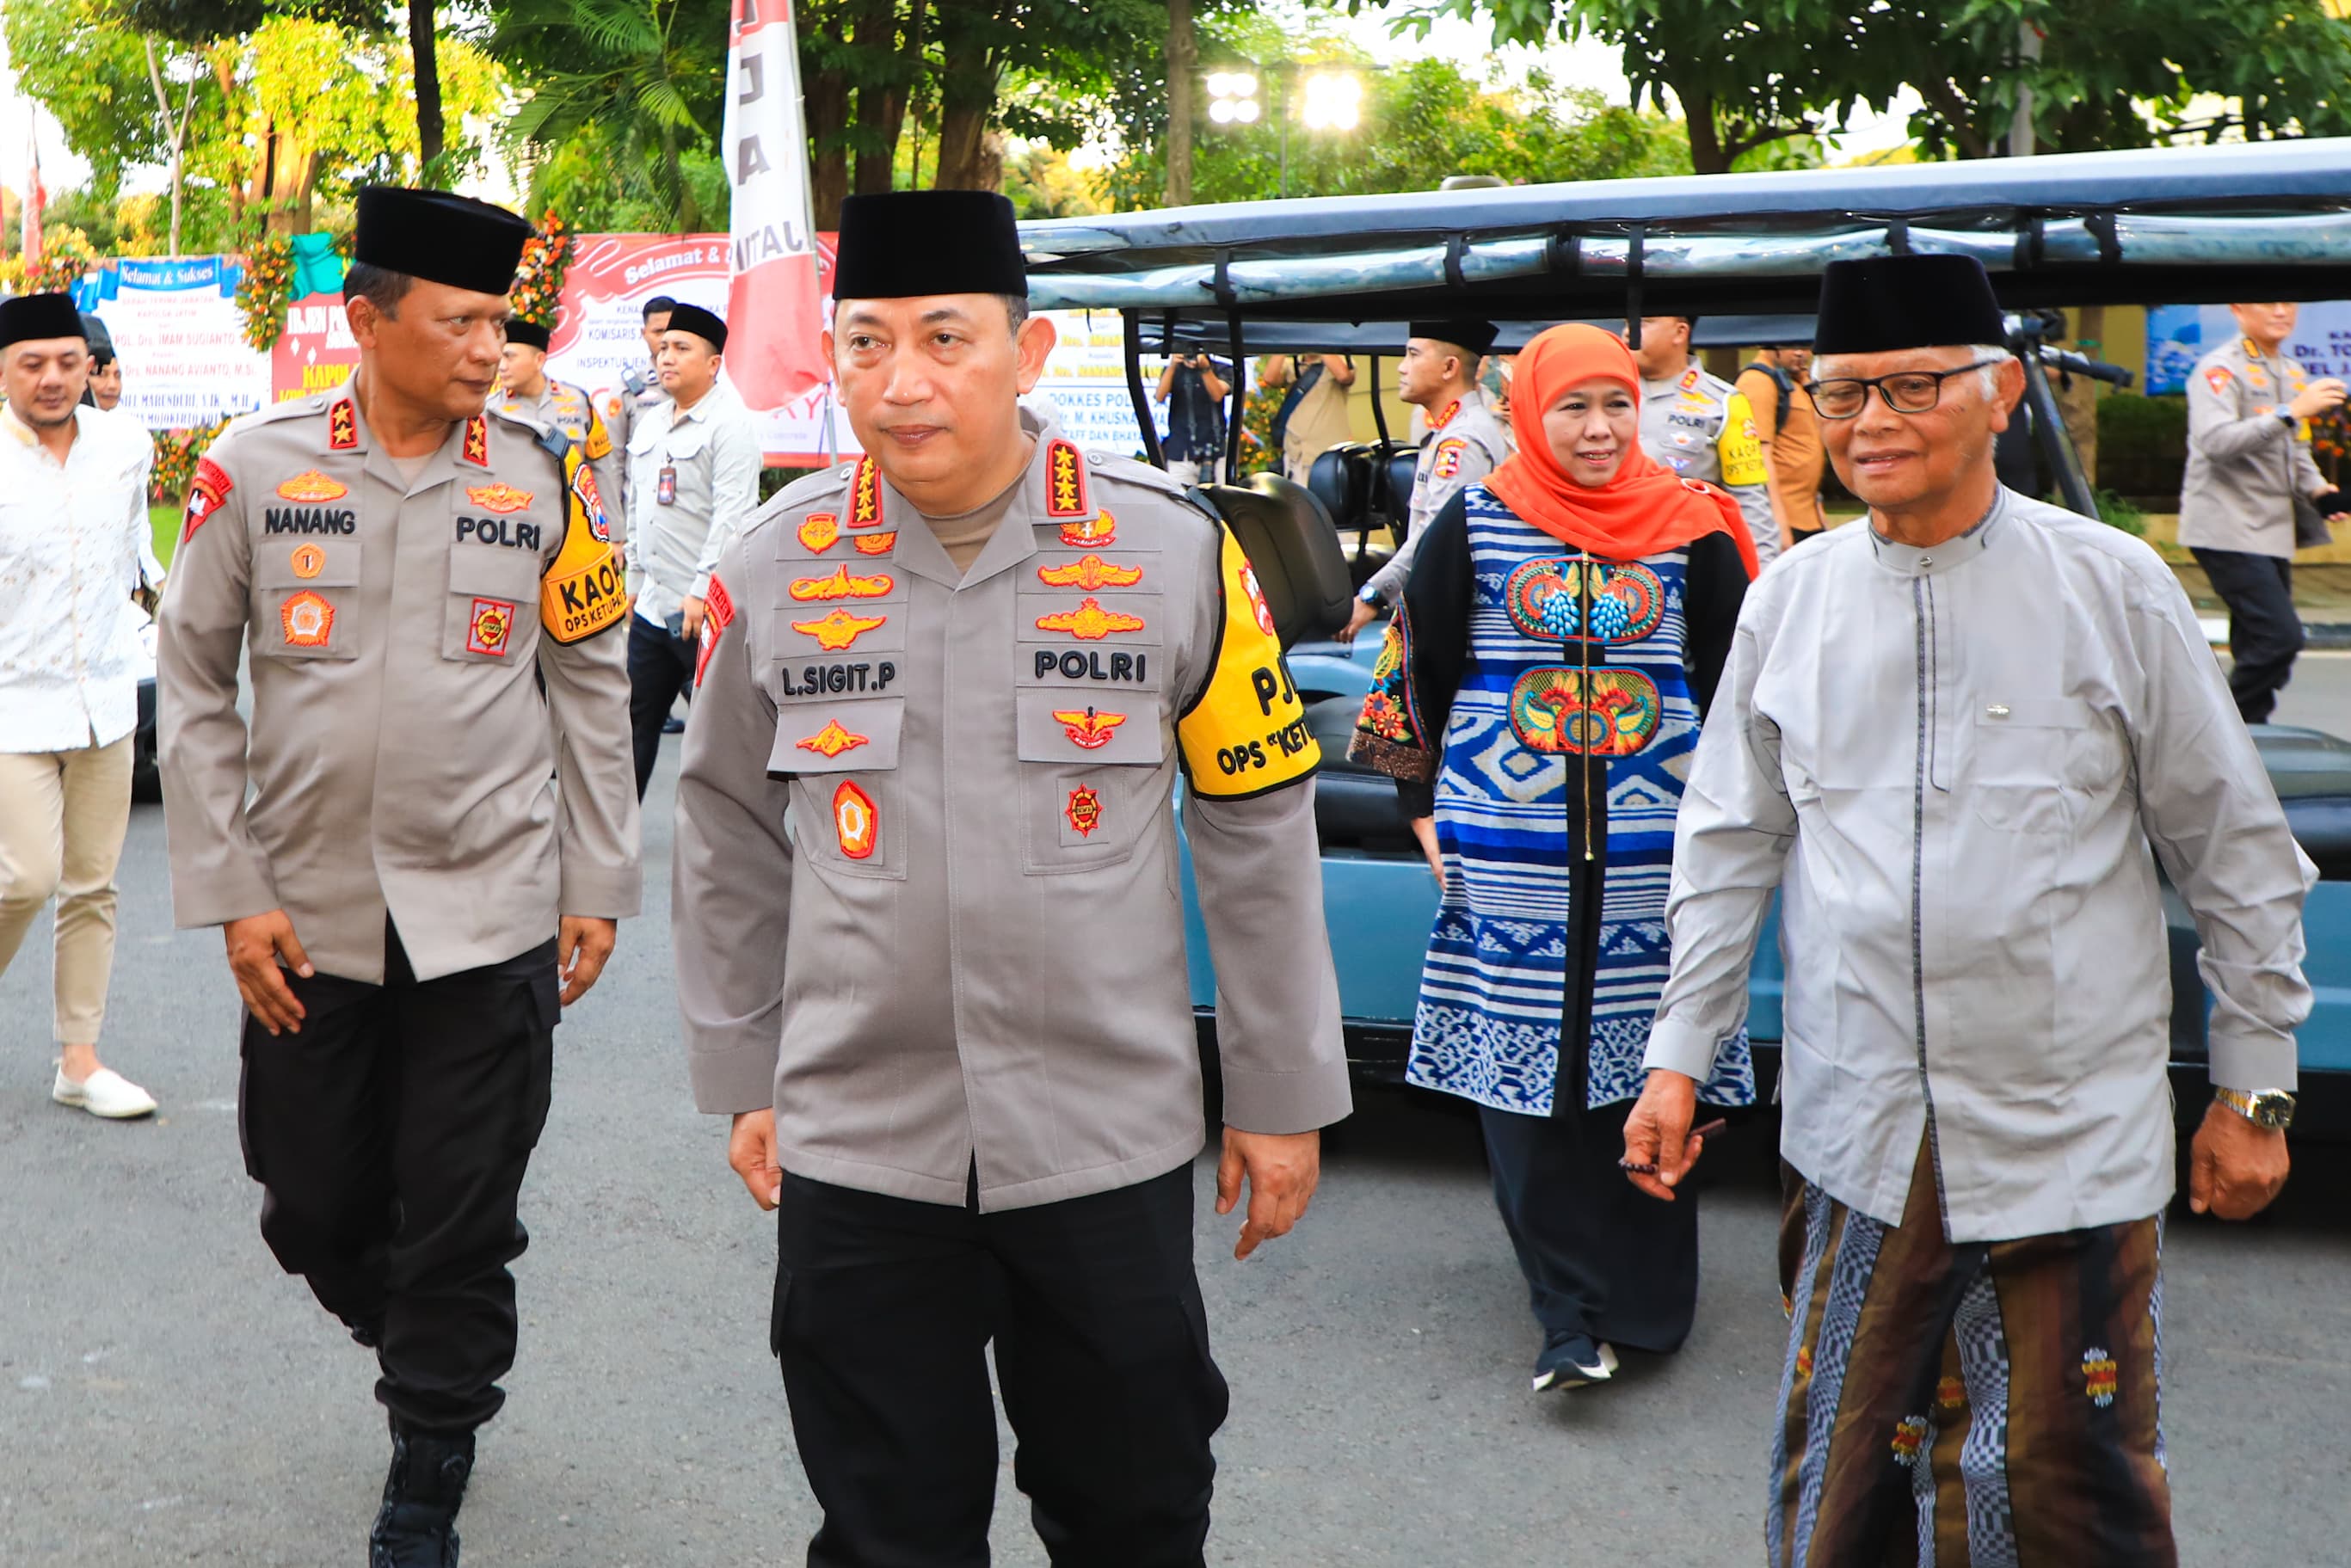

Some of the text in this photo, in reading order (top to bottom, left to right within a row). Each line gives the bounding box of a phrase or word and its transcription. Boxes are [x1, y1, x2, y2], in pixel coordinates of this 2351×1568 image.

[121, 266, 213, 285] Selamat & Sukses
[623, 246, 703, 286] Selamat
[707, 246, 720, 263] &
[158, 332, 183, 346] IMAM
[588, 328, 637, 341] KOMISARIS
[577, 357, 628, 369] INSPEKTUR
[1669, 415, 1708, 429] POLRI
[265, 507, 355, 535] NANANG
[456, 516, 541, 551] POLRI
[565, 613, 588, 632] OPS
[781, 661, 895, 697] L.SIGIT.P
[1035, 650, 1146, 683] POLRI
[1251, 650, 1299, 716] PJ
[1216, 740, 1266, 776] OPS
